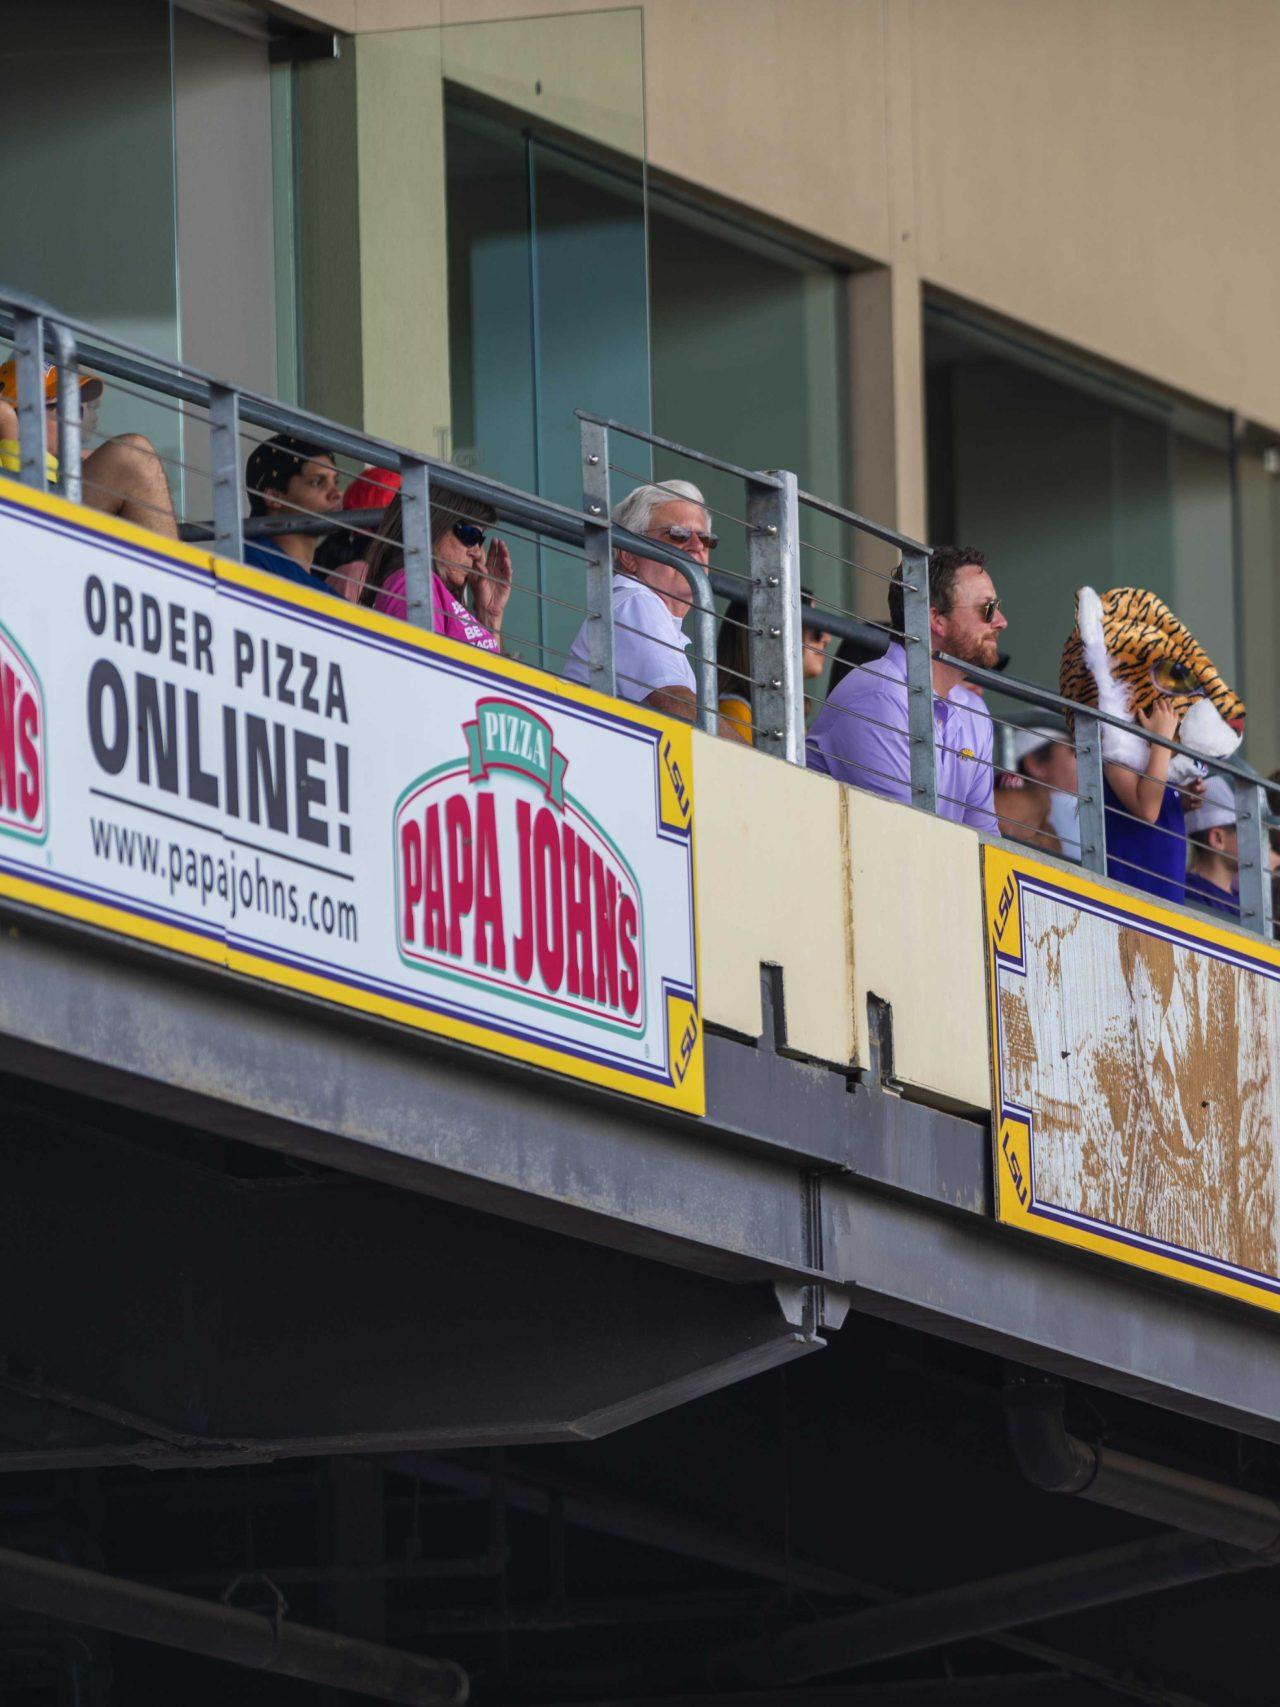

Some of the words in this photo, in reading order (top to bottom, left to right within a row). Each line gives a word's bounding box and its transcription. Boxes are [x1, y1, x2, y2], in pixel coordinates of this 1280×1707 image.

[85, 573, 214, 676] ORDER
[234, 628, 349, 725] PIZZA
[87, 657, 352, 856] ONLINE!
[484, 711, 547, 770] PIZZA
[664, 741, 690, 817] LSU
[90, 816, 358, 943] www.papajohns.com
[401, 792, 507, 972] PAPA
[513, 798, 640, 1017] JOHN'S
[994, 874, 1014, 940] LSU
[674, 1014, 698, 1084] LSU
[1002, 1131, 1028, 1206] LSU
